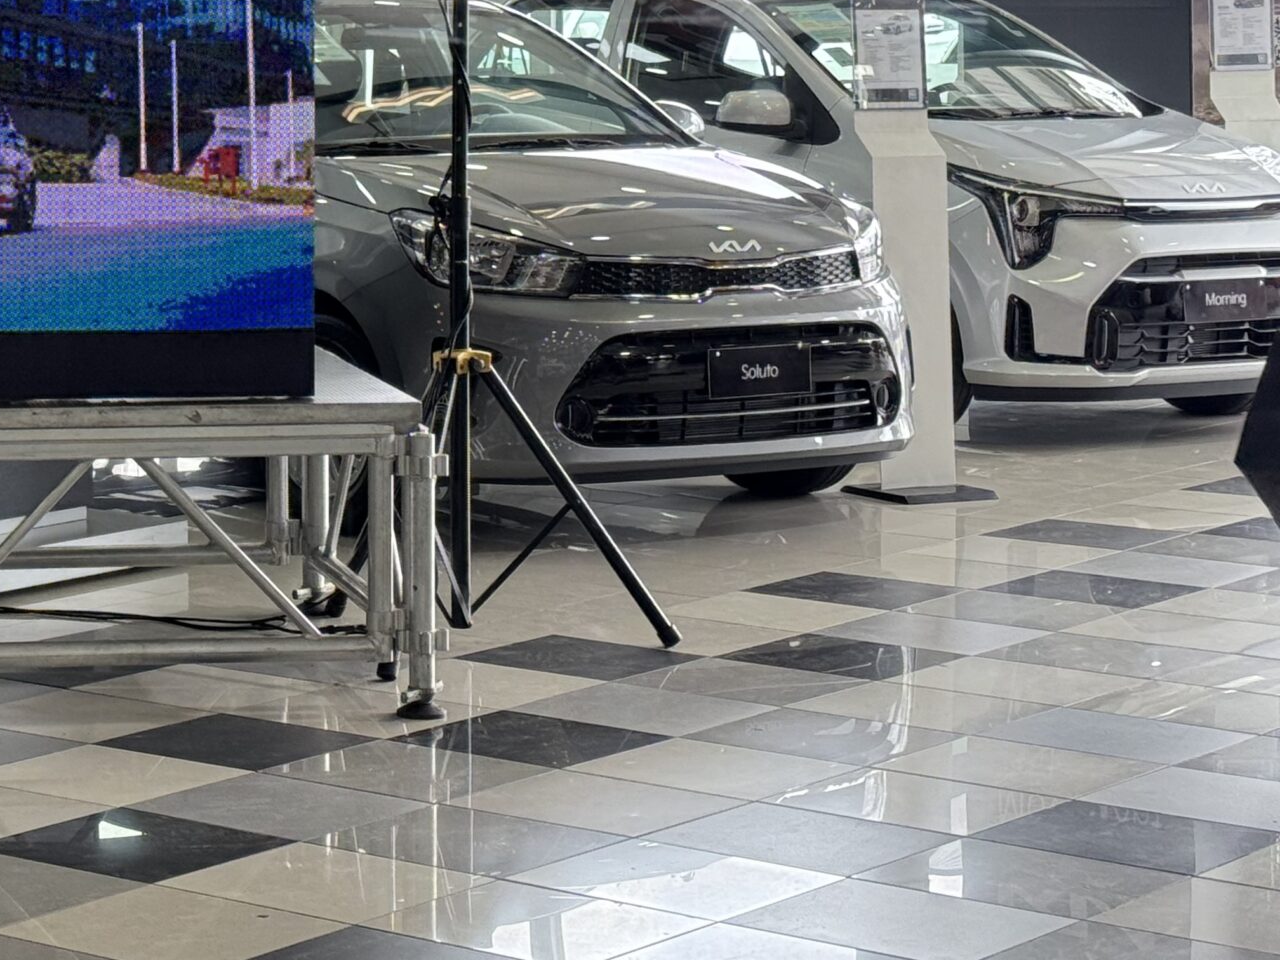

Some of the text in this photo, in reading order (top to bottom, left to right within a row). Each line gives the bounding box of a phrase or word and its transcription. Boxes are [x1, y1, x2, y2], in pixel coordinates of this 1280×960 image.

[709, 239, 762, 253] KIA
[1205, 292, 1247, 308] Morning
[741, 363, 779, 380] Soluto
